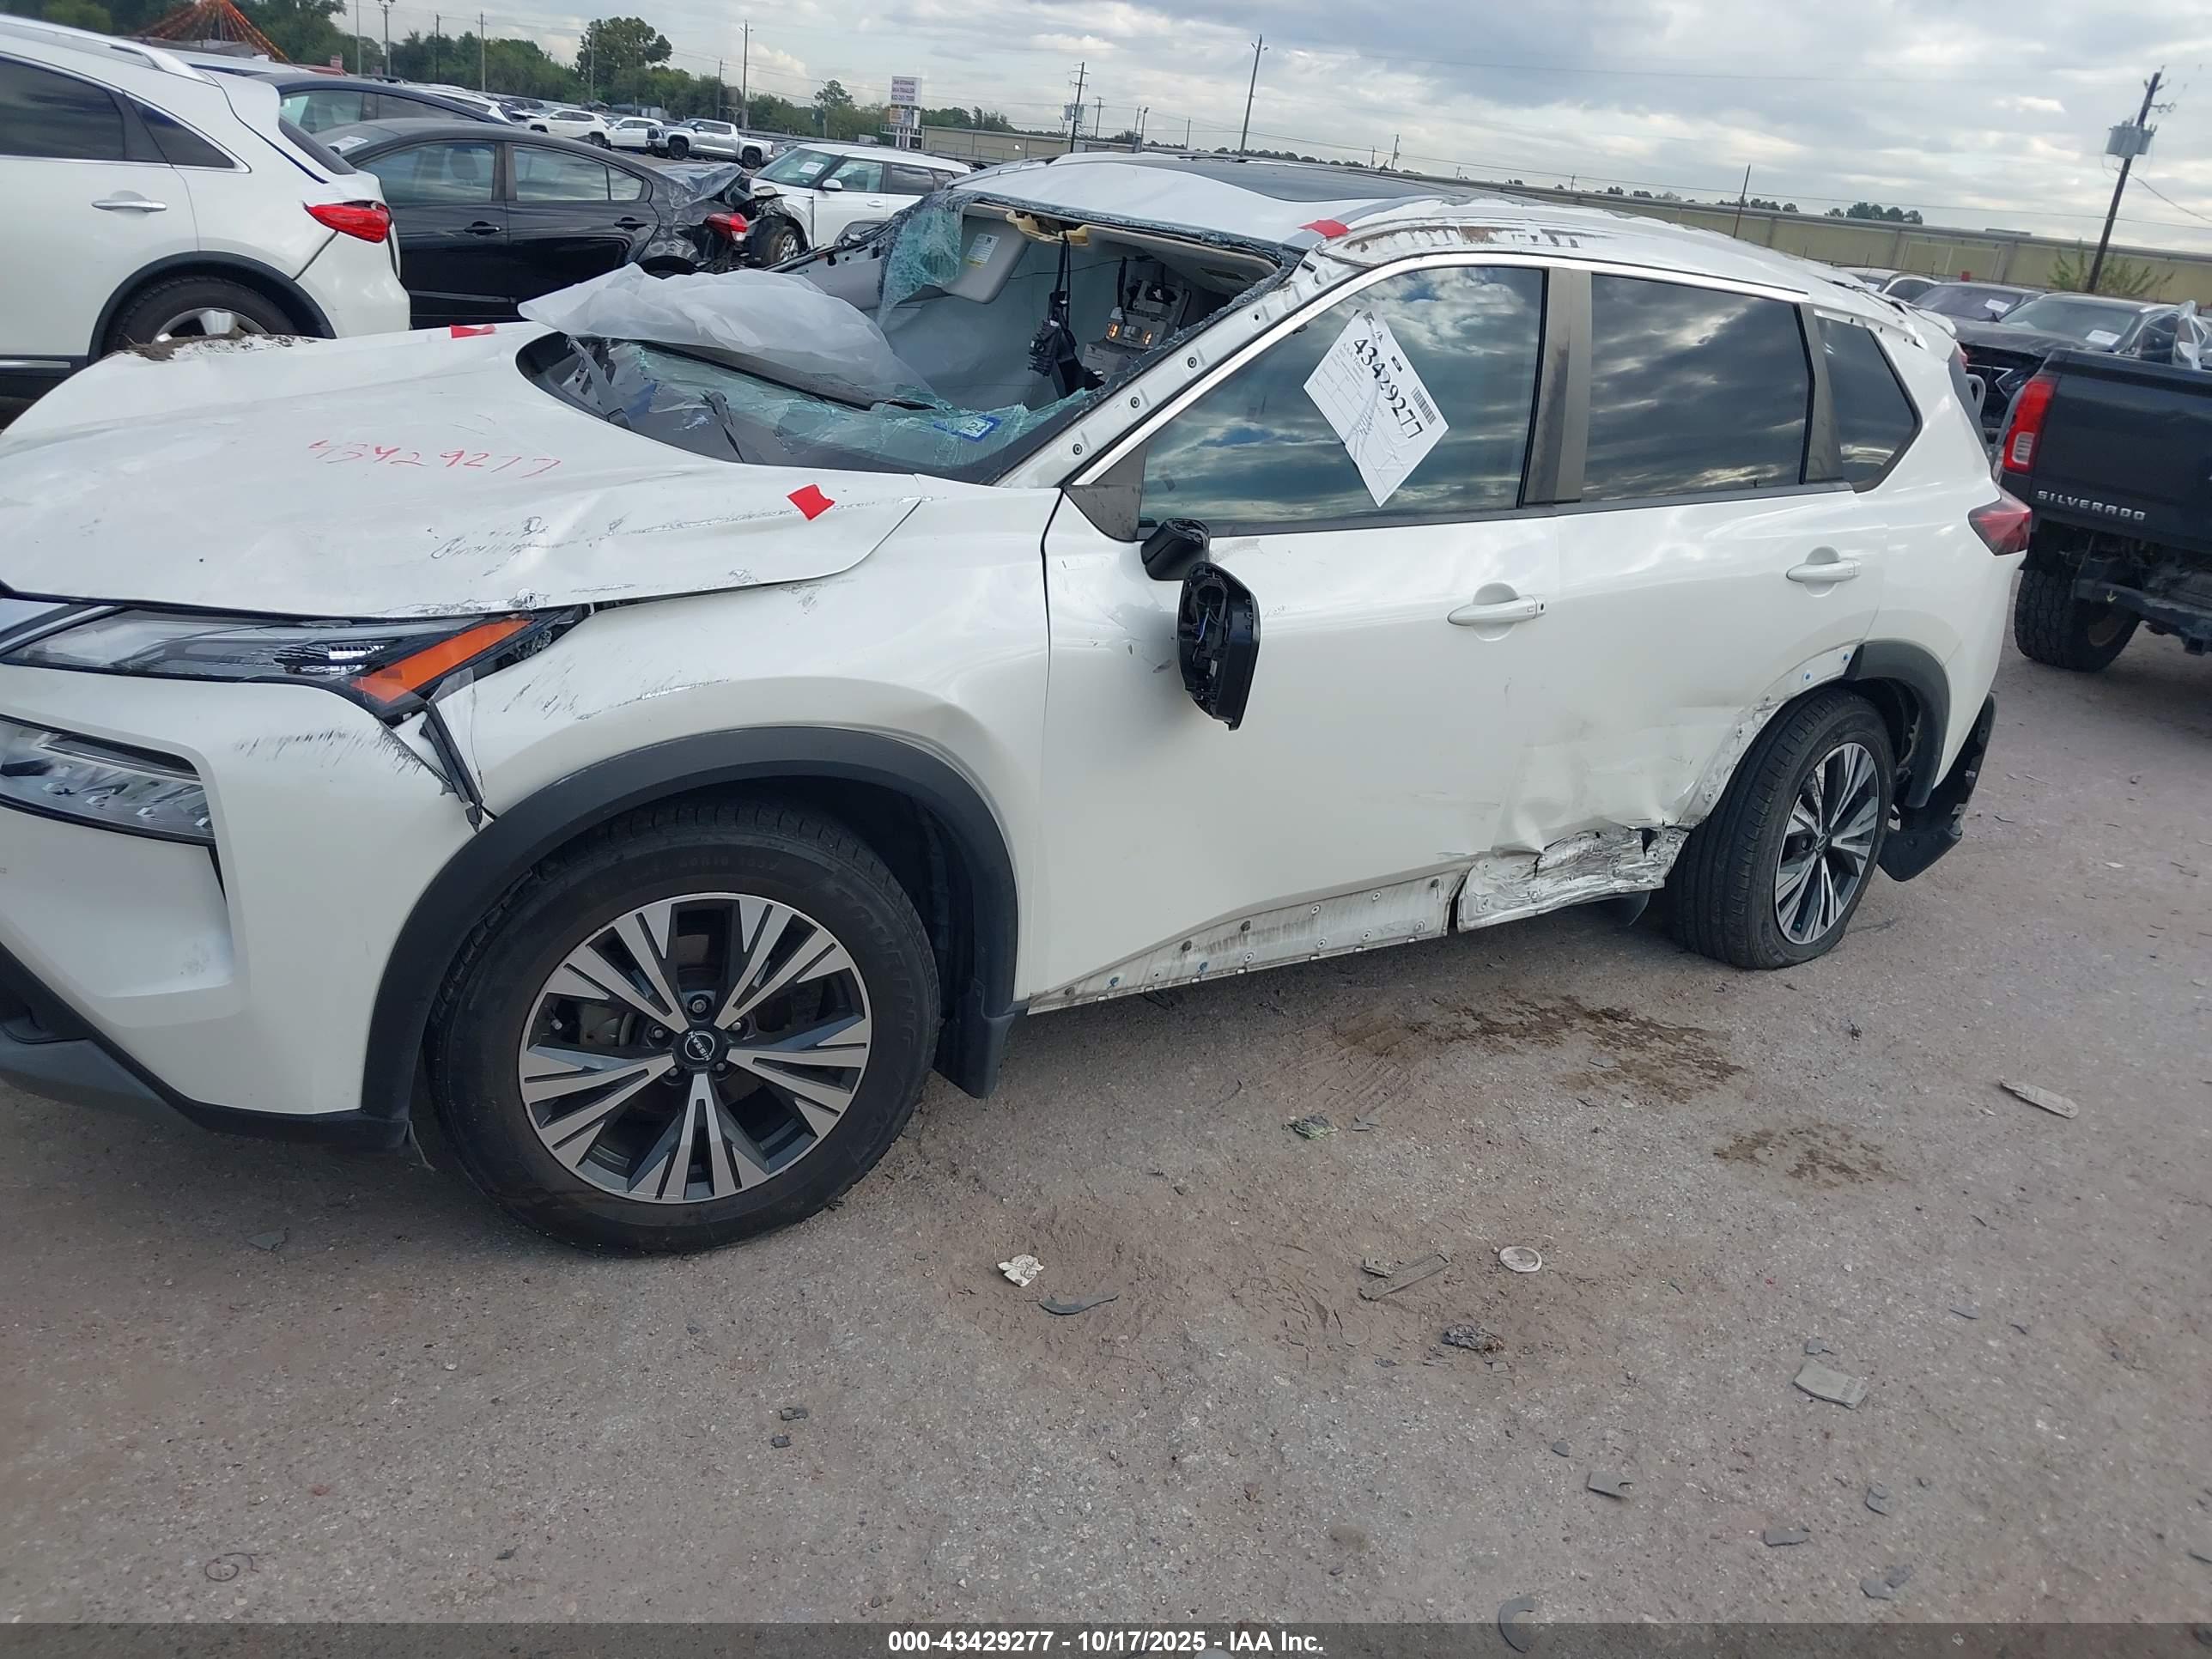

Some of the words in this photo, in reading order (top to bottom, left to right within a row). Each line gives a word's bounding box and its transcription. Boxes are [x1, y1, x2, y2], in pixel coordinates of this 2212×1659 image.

[1353, 339, 1424, 439] 43429277
[2037, 490, 2146, 520] SILVERADO
[687, 1030, 712, 1061] NISSAN
